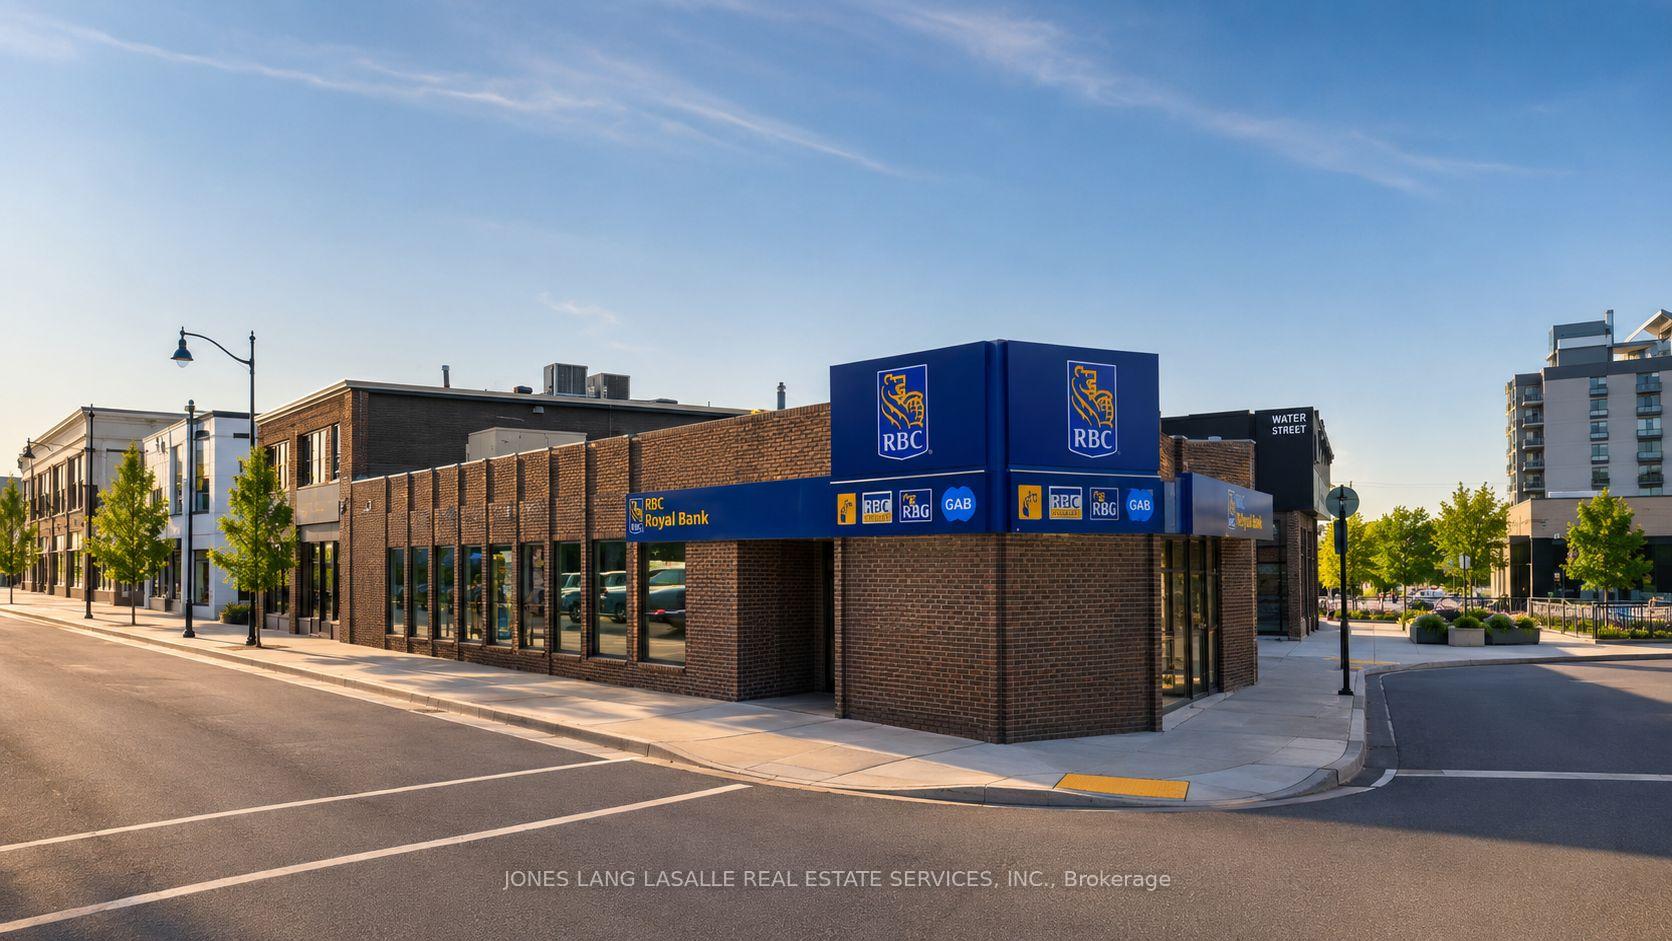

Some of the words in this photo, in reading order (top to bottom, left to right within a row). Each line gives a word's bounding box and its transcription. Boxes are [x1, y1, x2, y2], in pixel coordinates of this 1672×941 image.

[1272, 413, 1306, 424] WATER
[1272, 425, 1307, 435] STREET
[883, 430, 923, 451] RBC
[1074, 428, 1112, 449] RBC
[645, 497, 664, 511] RBC
[945, 498, 972, 510] GAB
[1129, 499, 1151, 511] GAB
[645, 511, 675, 530] Royal
[678, 510, 709, 526] Bank
